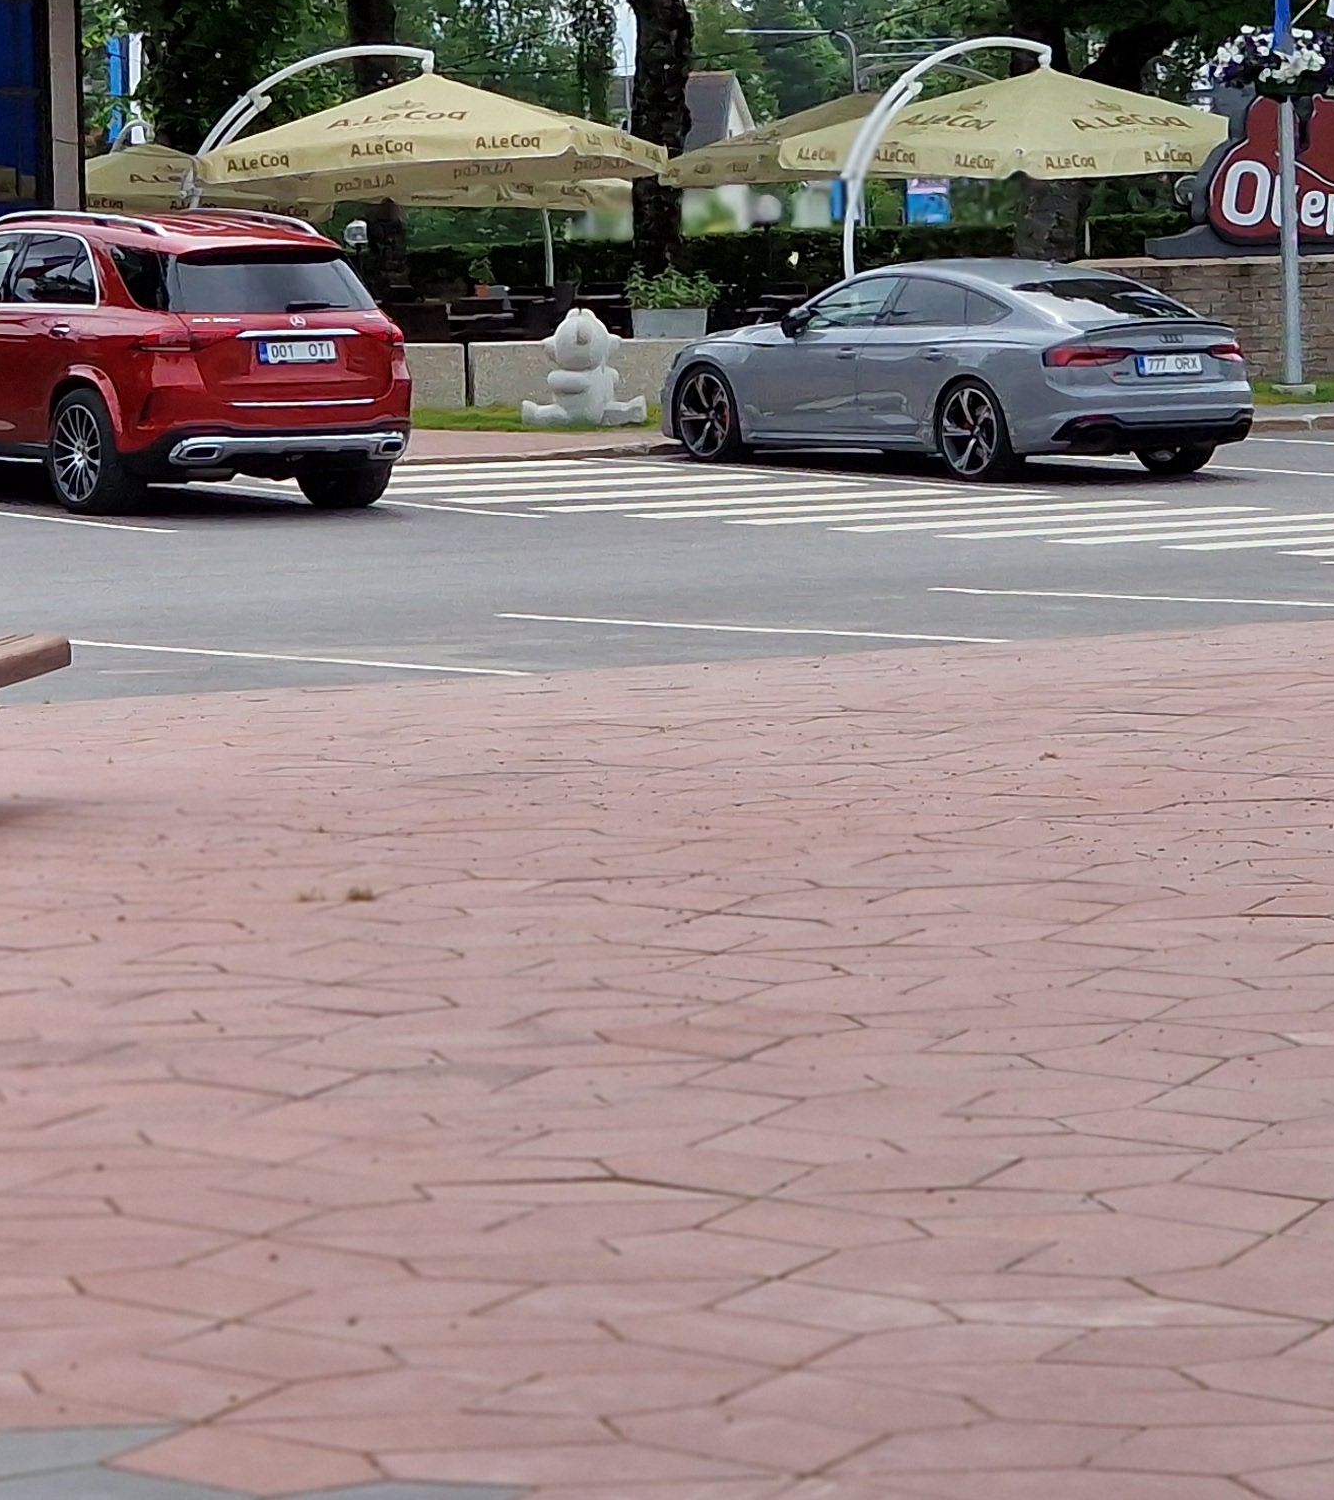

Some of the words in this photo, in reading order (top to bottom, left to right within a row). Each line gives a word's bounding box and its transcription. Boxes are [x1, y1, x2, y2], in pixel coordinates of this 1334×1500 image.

[271, 343, 295, 359] 001
[308, 342, 331, 358] OTI
[1147, 358, 1167, 371] 777
[1174, 357, 1199, 370] ORX
